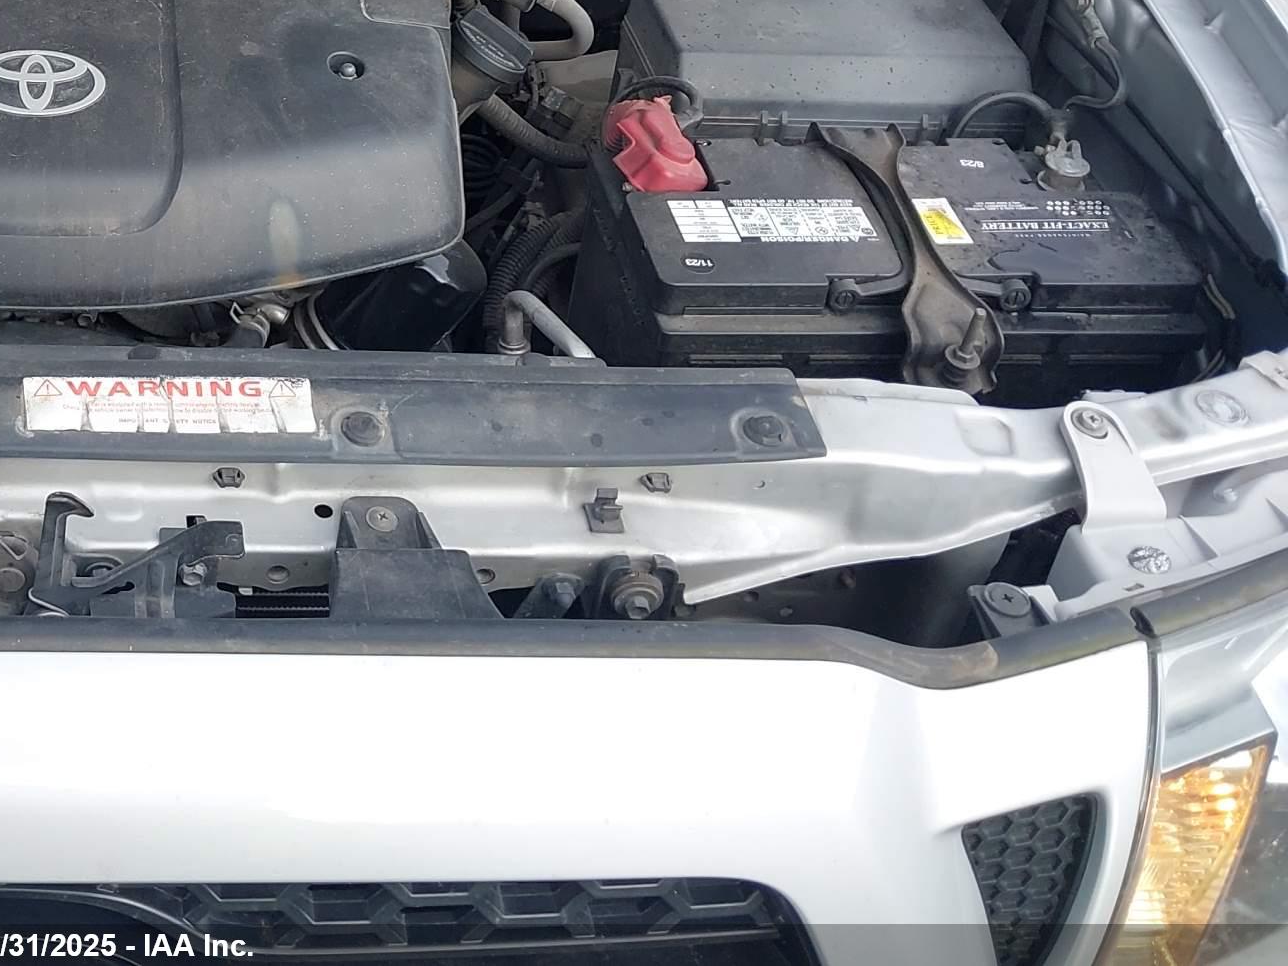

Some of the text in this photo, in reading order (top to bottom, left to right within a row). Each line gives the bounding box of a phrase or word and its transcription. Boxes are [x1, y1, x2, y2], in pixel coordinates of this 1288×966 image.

[981, 221, 1109, 230] EXACT-FIT BATTERY
[66, 380, 262, 398] WARNING
